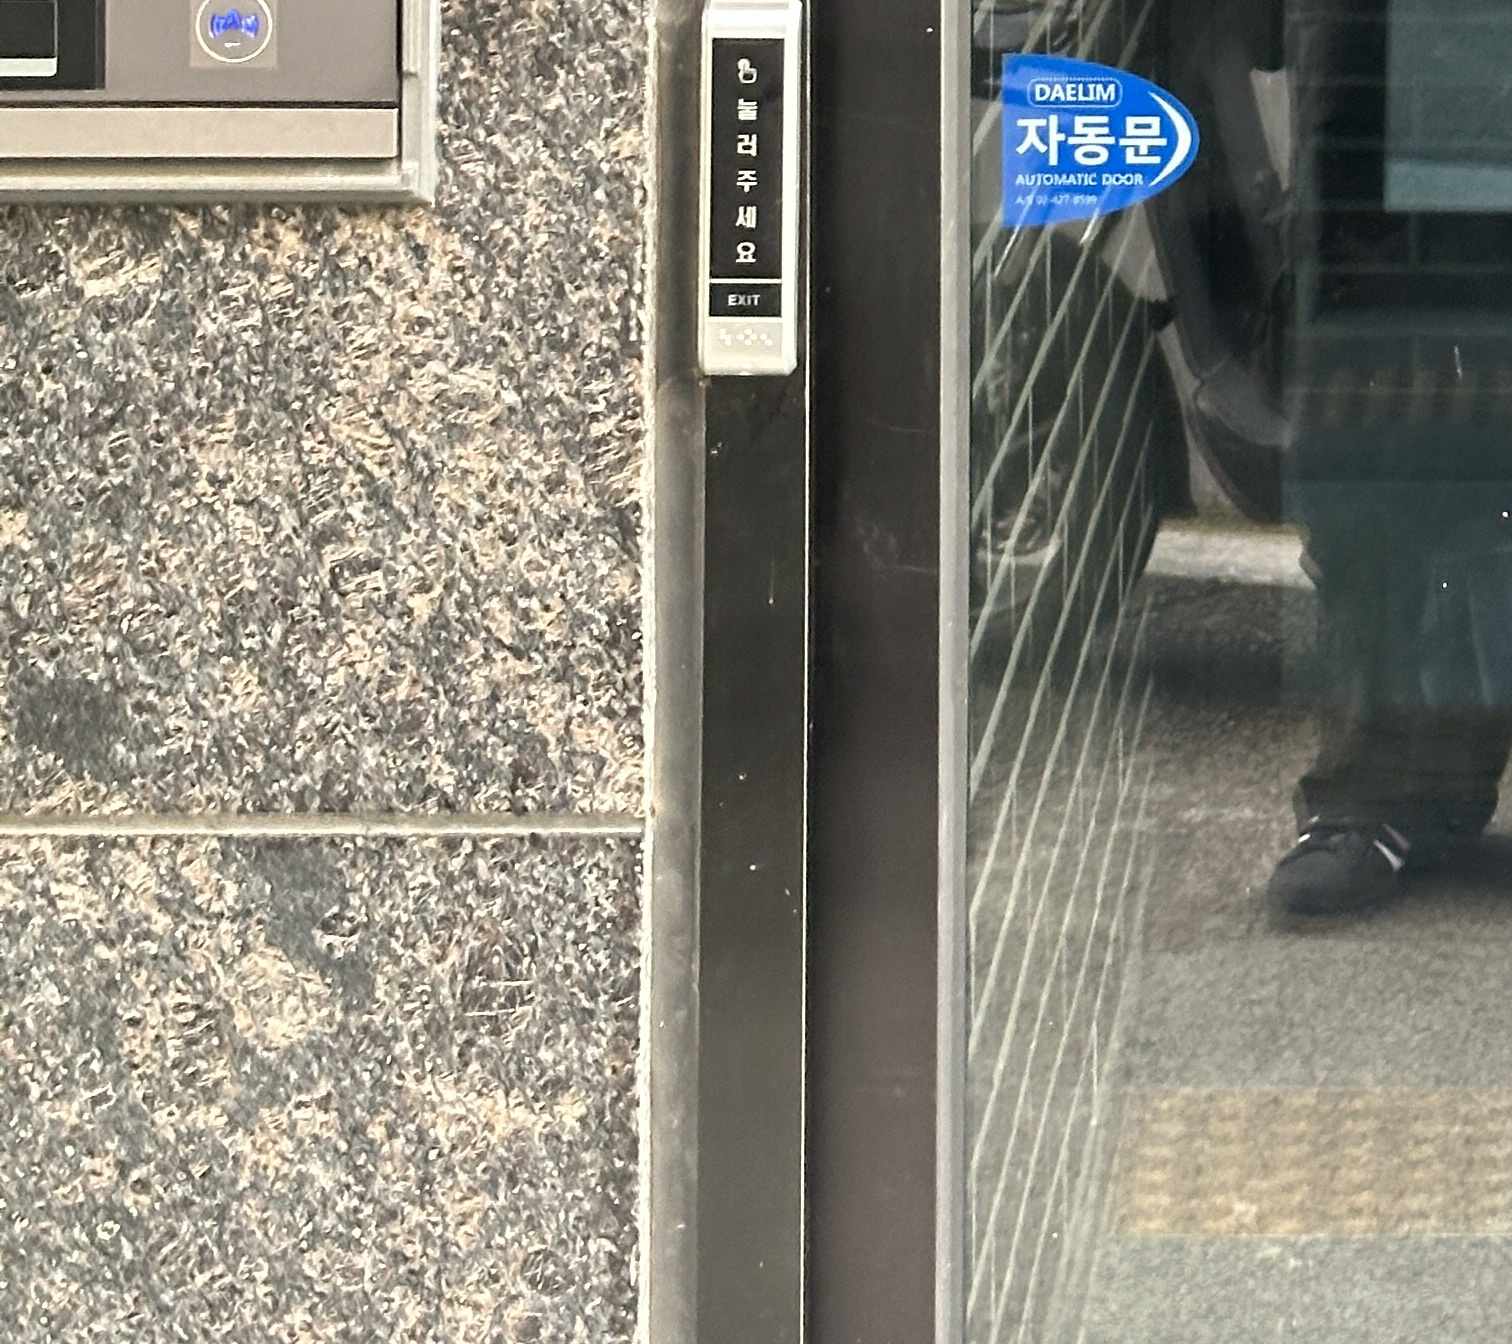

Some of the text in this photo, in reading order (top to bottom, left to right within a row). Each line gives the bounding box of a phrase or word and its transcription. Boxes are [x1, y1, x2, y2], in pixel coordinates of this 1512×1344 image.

[1034, 84, 1116, 102] DAELIM
[1015, 114, 1168, 166] 자동문
[735, 98, 758, 264] 눌러주세요
[1015, 172, 1144, 186] AUTOMATIC DOOR
[727, 294, 761, 307] EXIT
